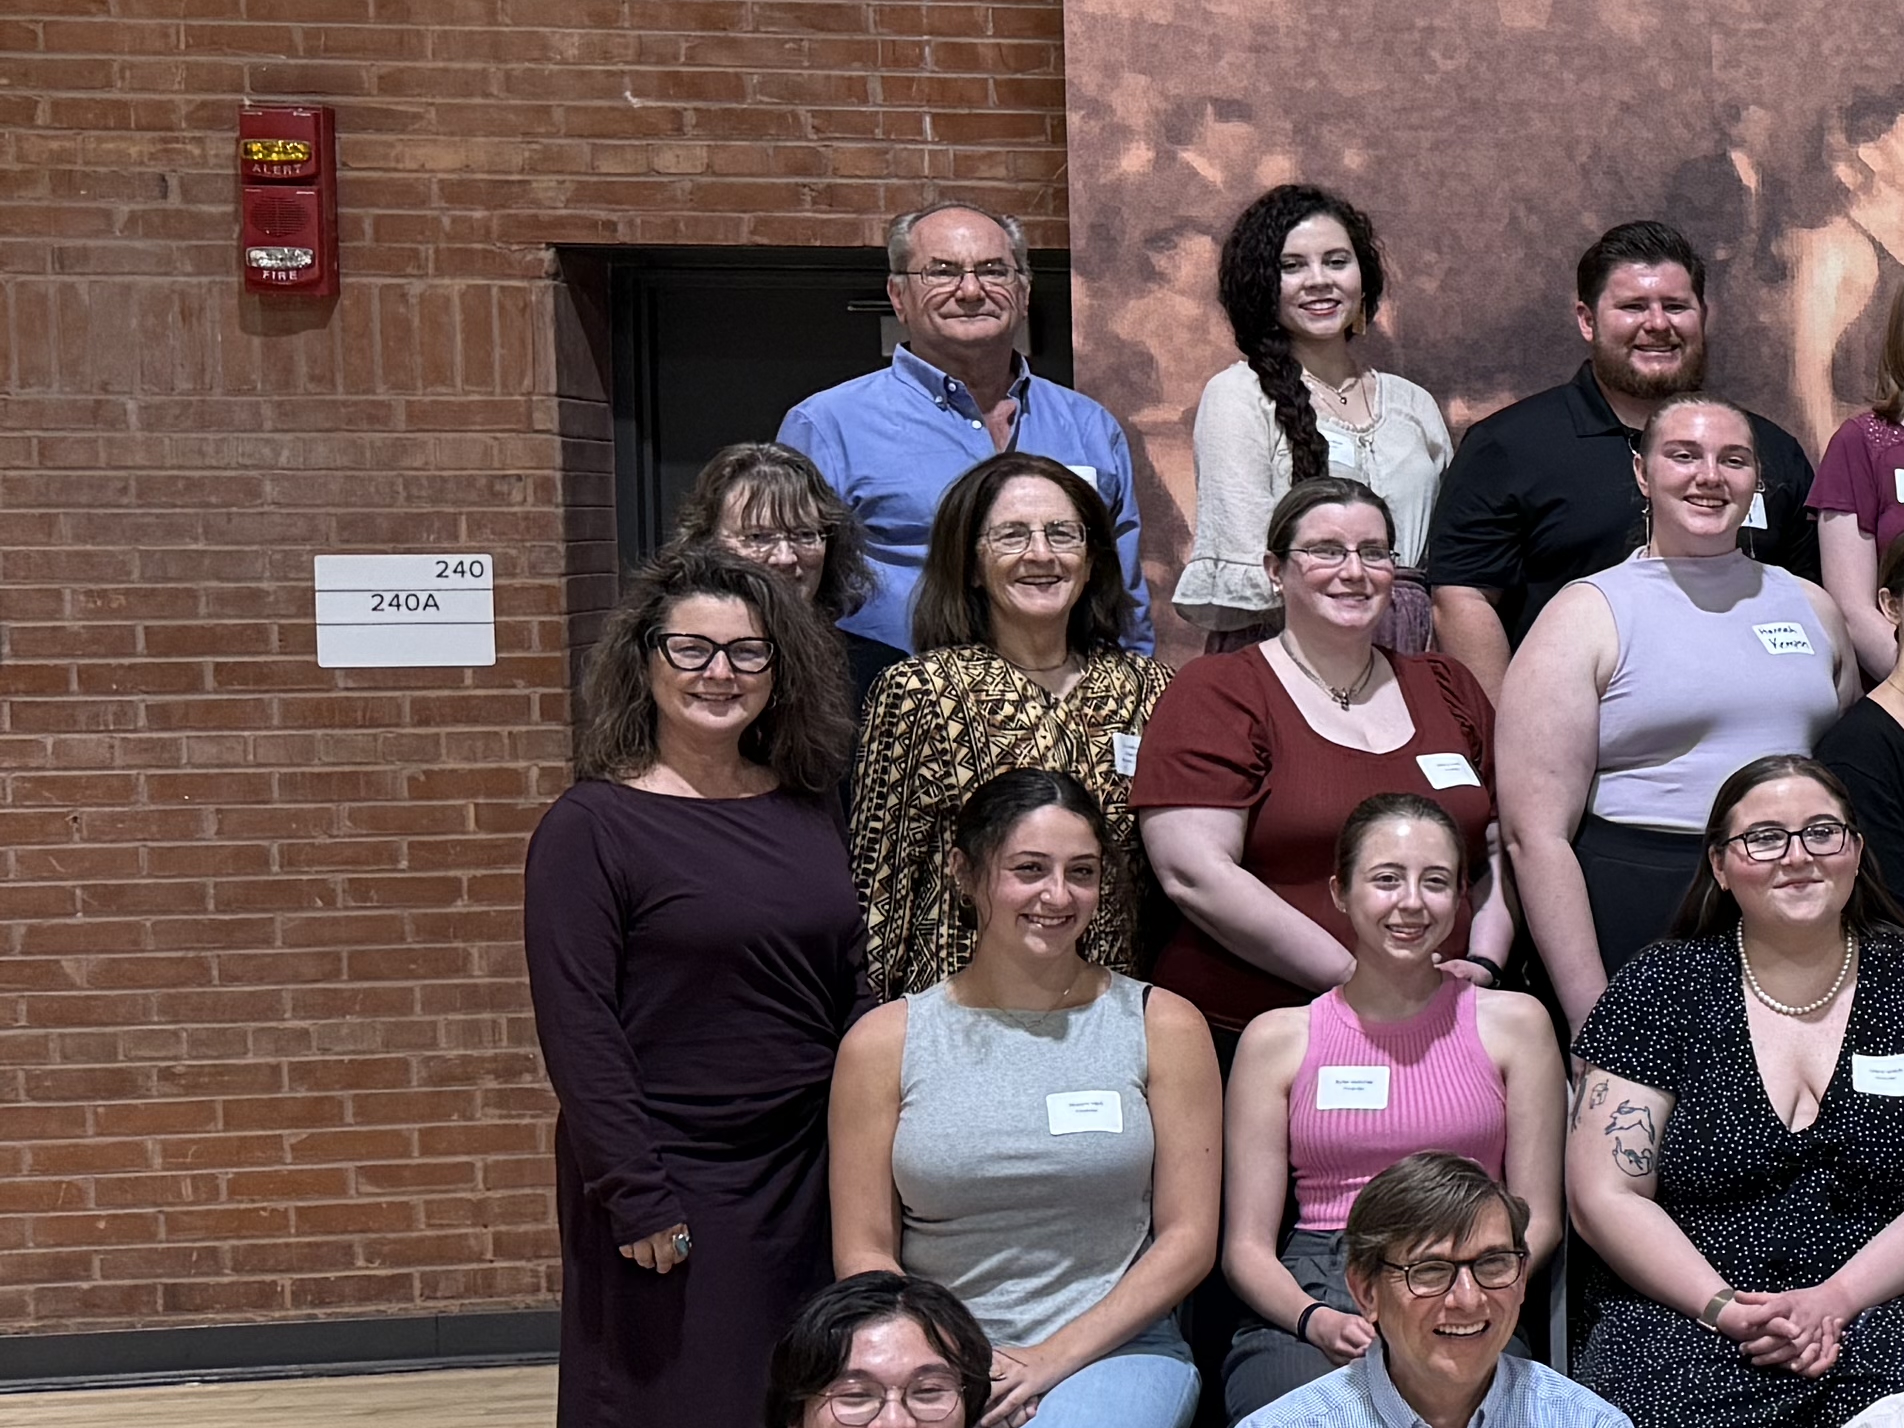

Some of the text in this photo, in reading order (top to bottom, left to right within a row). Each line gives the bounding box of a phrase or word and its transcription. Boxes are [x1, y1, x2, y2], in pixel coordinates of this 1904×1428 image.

[252, 163, 302, 176] ALERT
[262, 269, 298, 281] FIRE
[435, 559, 485, 579] 240
[371, 593, 440, 612] 240A
